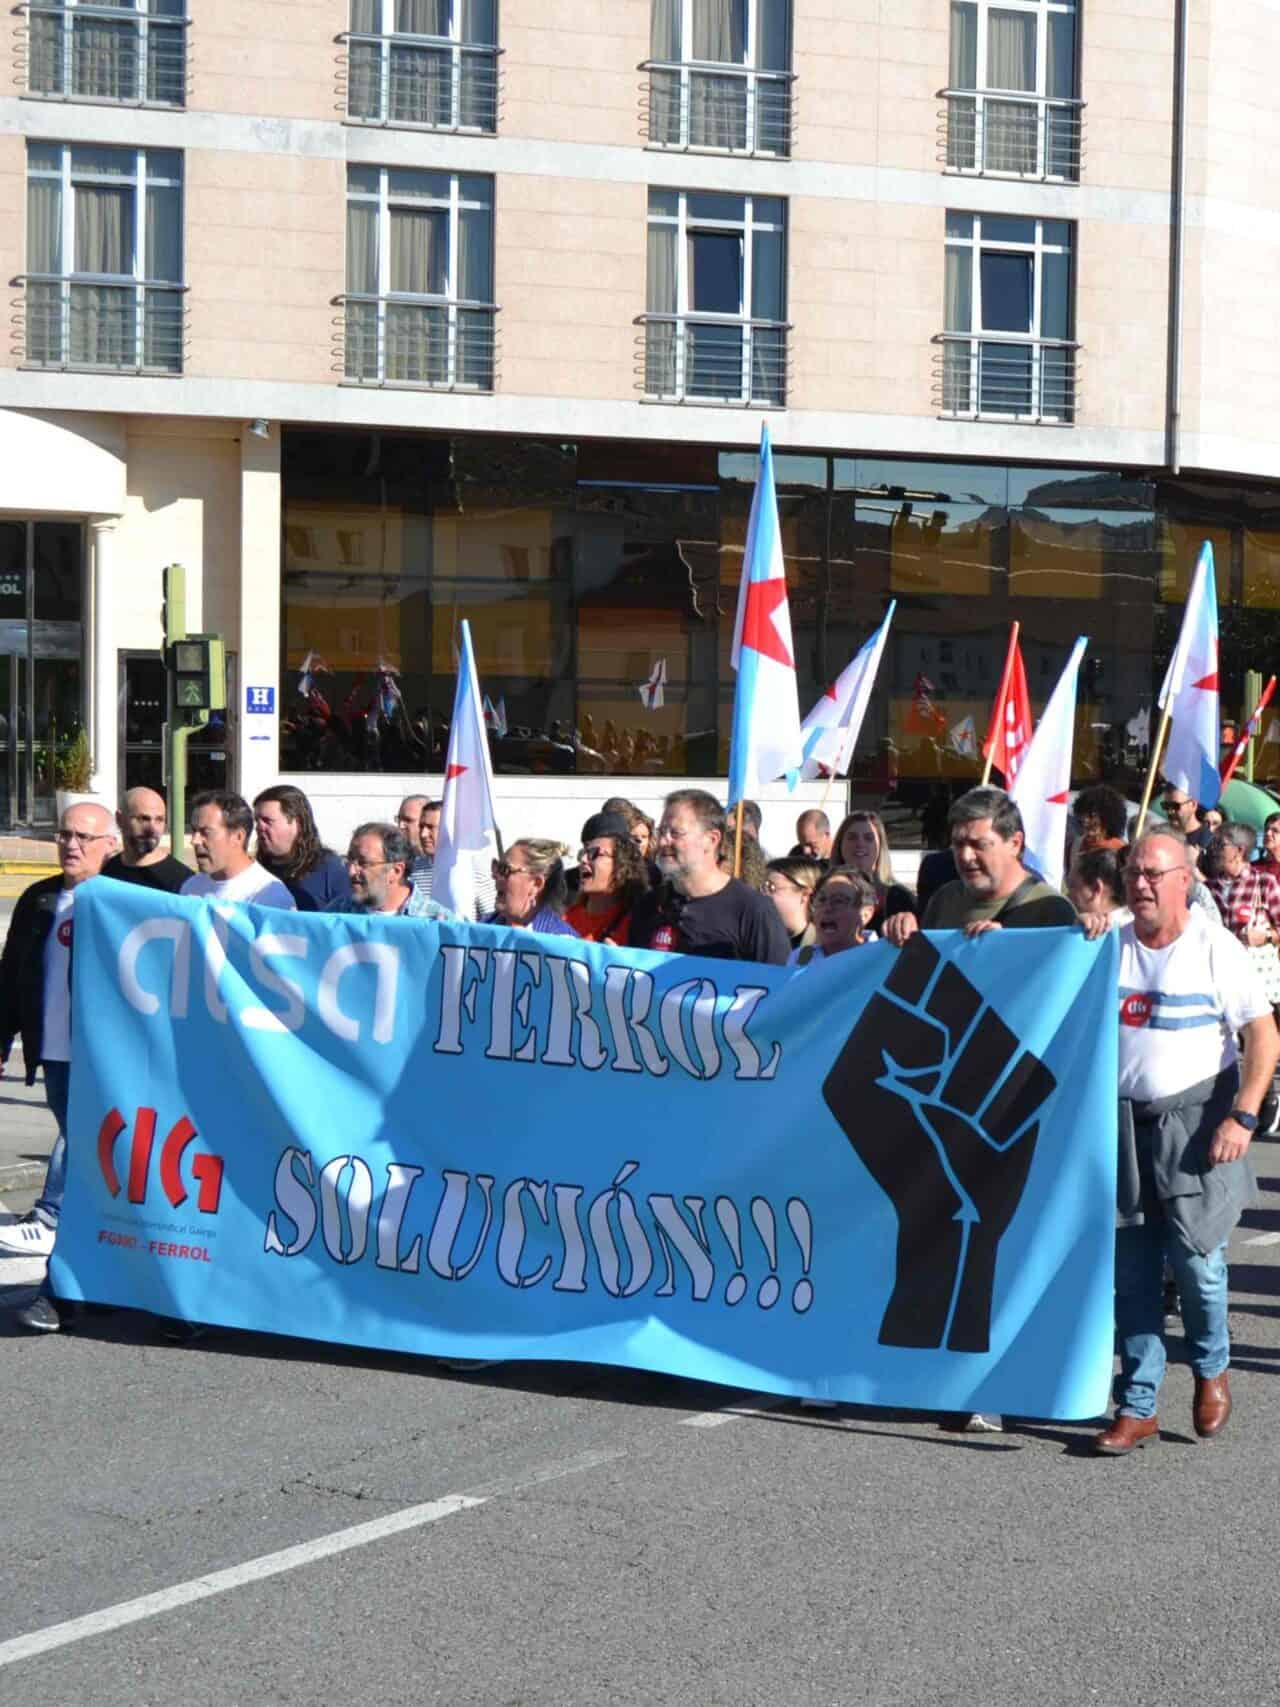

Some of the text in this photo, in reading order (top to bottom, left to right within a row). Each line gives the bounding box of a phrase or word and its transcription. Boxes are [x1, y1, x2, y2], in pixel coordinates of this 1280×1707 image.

[118, 908, 400, 1045] alsa
[433, 944, 782, 1081] FERROL
[97, 1106, 225, 1214] CIG
[148, 1240, 212, 1263] FERROL
[264, 1145, 814, 1314] SOLUCIÓN!!!
